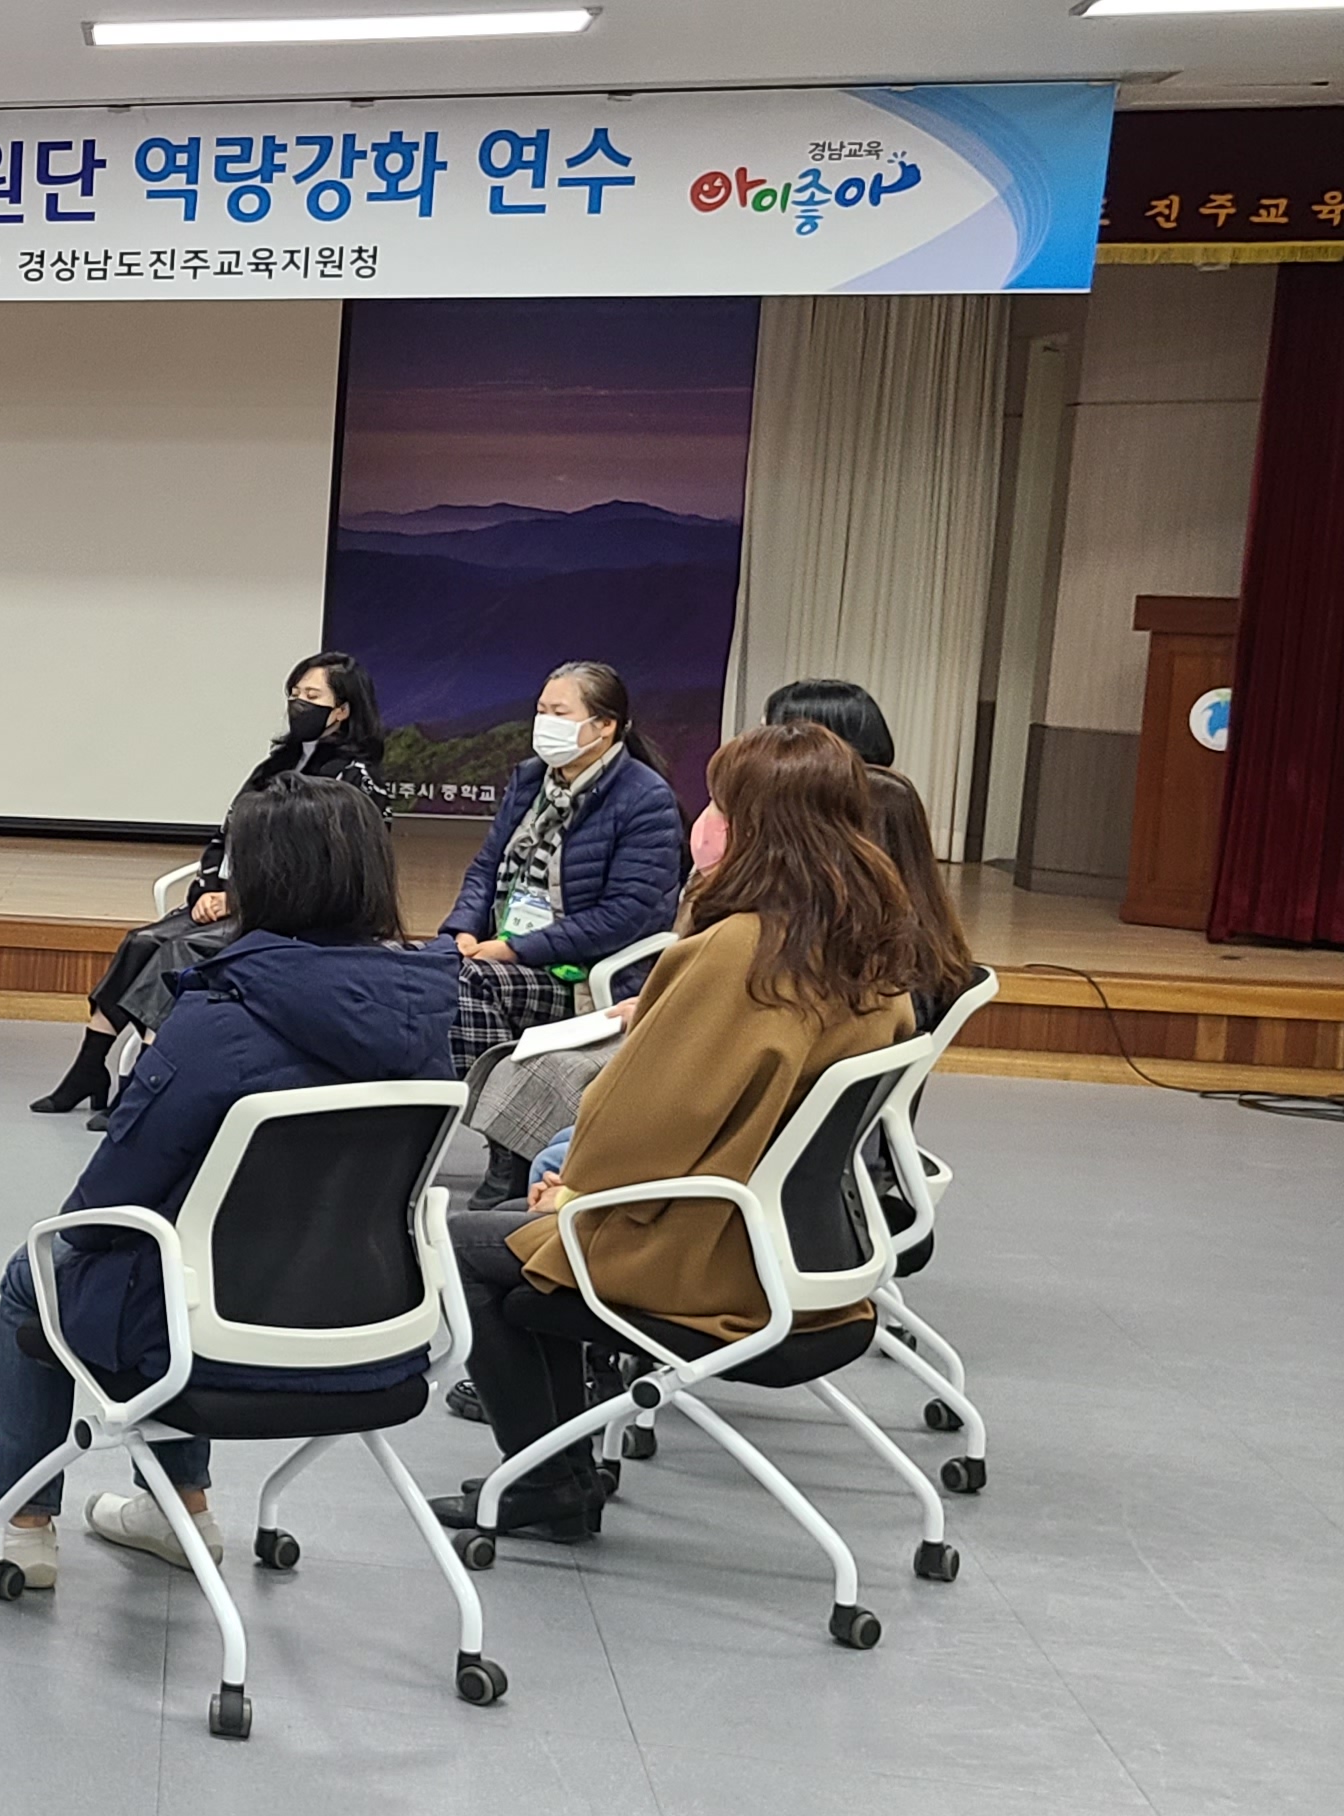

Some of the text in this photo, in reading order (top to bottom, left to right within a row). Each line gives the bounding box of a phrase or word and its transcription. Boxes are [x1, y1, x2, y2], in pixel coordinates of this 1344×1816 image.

[135, 130, 448, 223] 역량강화
[478, 127, 636, 215] 연수
[808, 140, 883, 162] 경남교육
[690, 161, 921, 236] 아이좋아
[18, 245, 379, 282] 경상남도진주교육지원청
